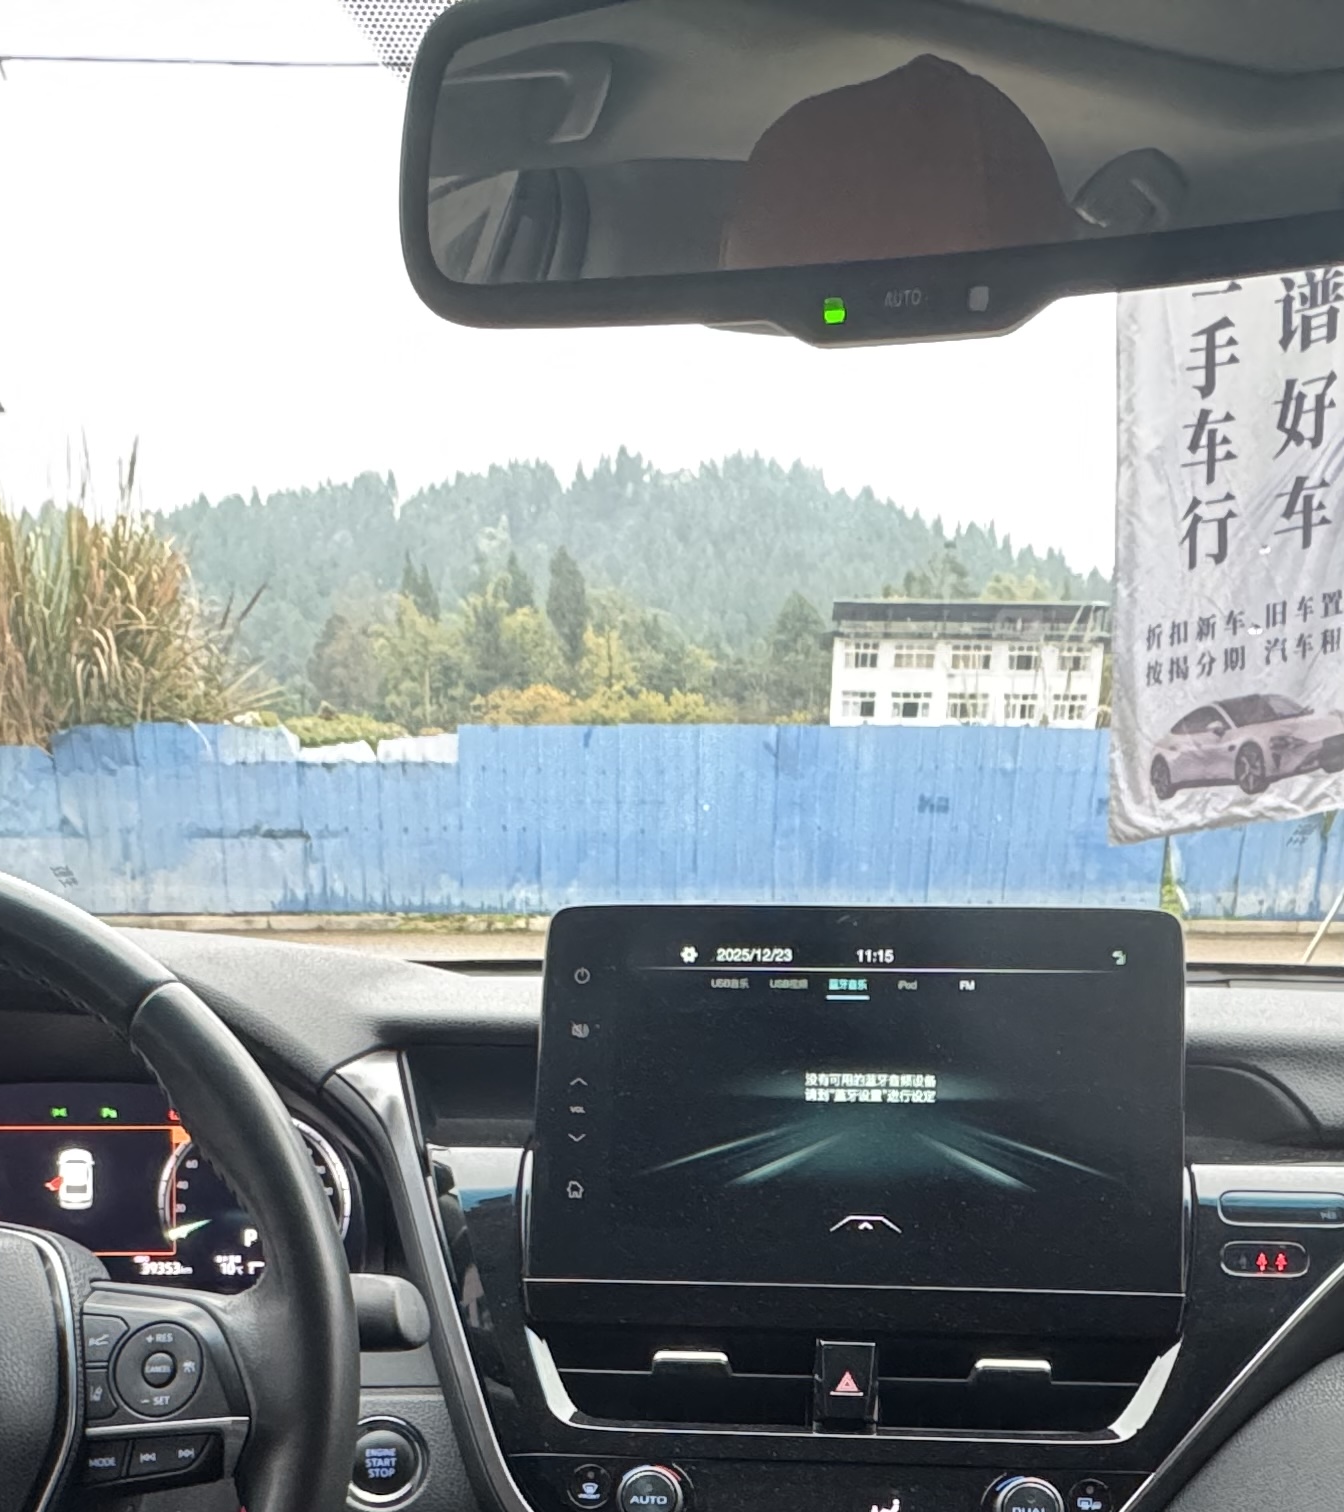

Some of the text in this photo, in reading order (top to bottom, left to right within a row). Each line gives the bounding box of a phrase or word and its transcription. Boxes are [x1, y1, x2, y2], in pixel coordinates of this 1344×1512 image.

[884, 289, 922, 307] AUTO
[1273, 268, 1344, 550] 谱好车
[1145, 645, 1246, 688] 按揭分期
[716, 947, 793, 962] 2025/12/23
[856, 948, 895, 964] 11:15
[897, 979, 918, 990] iPod
[959, 980, 976, 991] FM
[89, 1457, 116, 1468] MODE
[365, 1458, 397, 1468] START
[367, 1468, 396, 1479] STOP
[629, 1495, 668, 1505] AUTO
